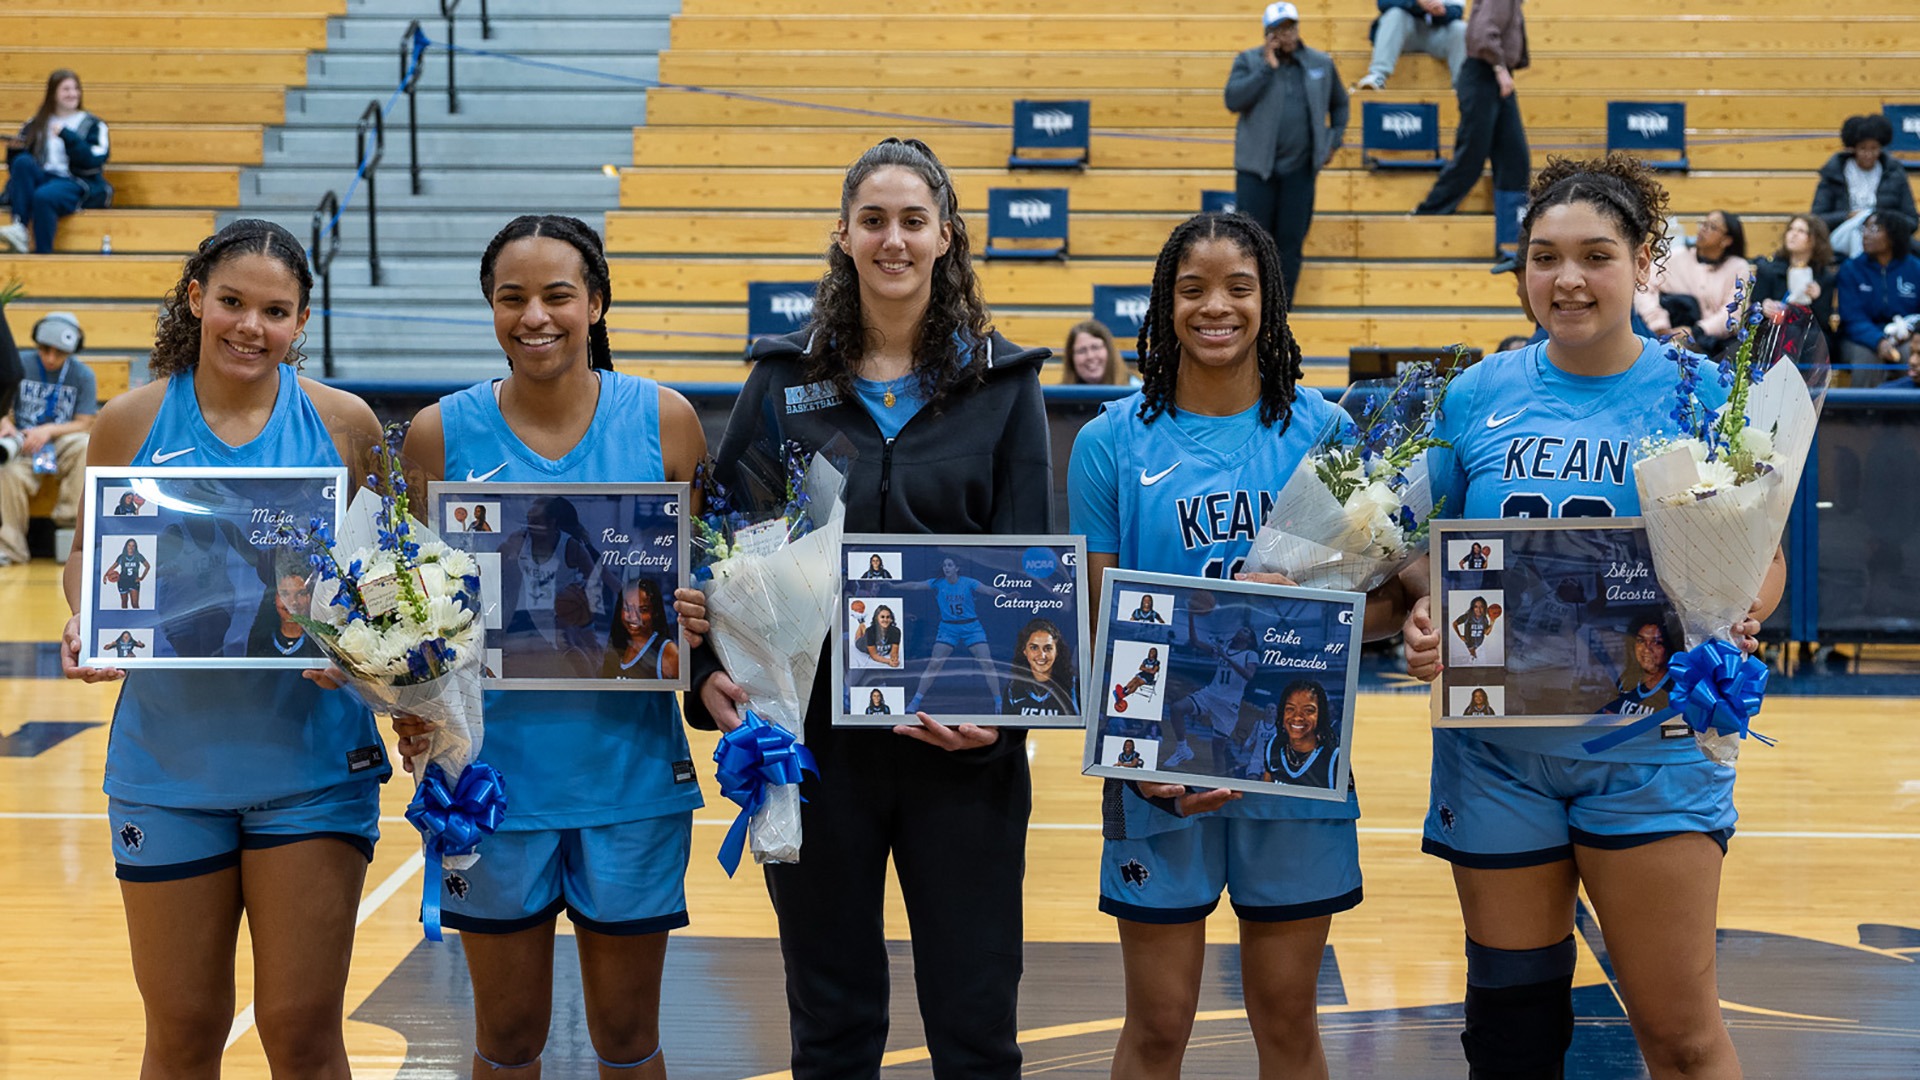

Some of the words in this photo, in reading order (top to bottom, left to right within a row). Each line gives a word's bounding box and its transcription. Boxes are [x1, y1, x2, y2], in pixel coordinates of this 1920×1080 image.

[785, 397, 843, 414] BASKETBALL
[1502, 435, 1629, 486] KEAN
[251, 508, 294, 533] Maya
[601, 527, 630, 543] Rae
[653, 534, 675, 547] #15
[602, 550, 673, 572] McClarty
[1025, 560, 1055, 570] NCAA
[127, 567, 133, 576] 5
[1604, 561, 1648, 584] Skyla
[993, 573, 1033, 588] Anna
[1052, 582, 1073, 594] #12
[1605, 585, 1656, 601] Acosta
[950, 603, 964, 617] 15
[994, 594, 1064, 615] Catanzaro
[1263, 628, 1301, 645] Erika
[1324, 643, 1344, 655] #11
[1262, 650, 1328, 670] Mercedes
[1619, 700, 1655, 715] KEAN
